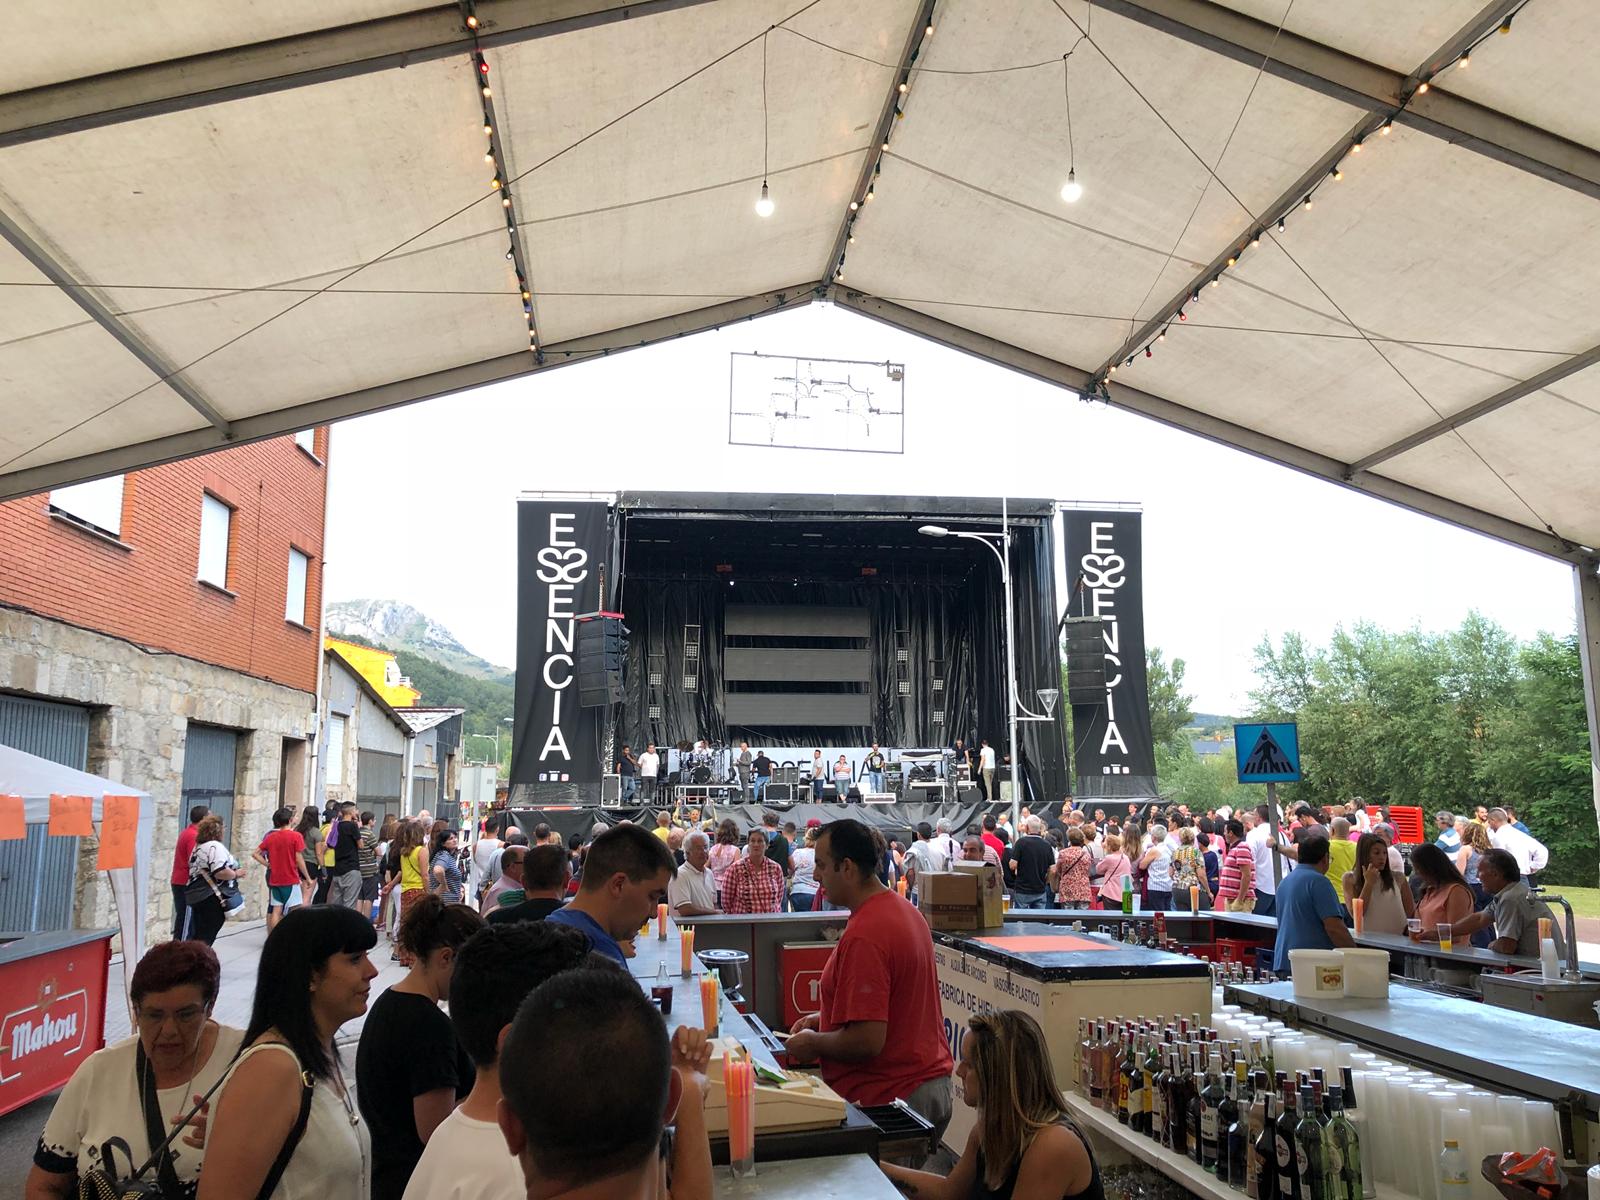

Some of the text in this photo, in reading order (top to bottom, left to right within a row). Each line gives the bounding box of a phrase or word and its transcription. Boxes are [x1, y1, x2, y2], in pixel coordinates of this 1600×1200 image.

[536, 512, 588, 761] ESSENCIA
[938, 980, 994, 1016] FABRICA DE HIE
[1015, 984, 1040, 1007] PLASTICO
[11, 1011, 78, 1061] Mahou
